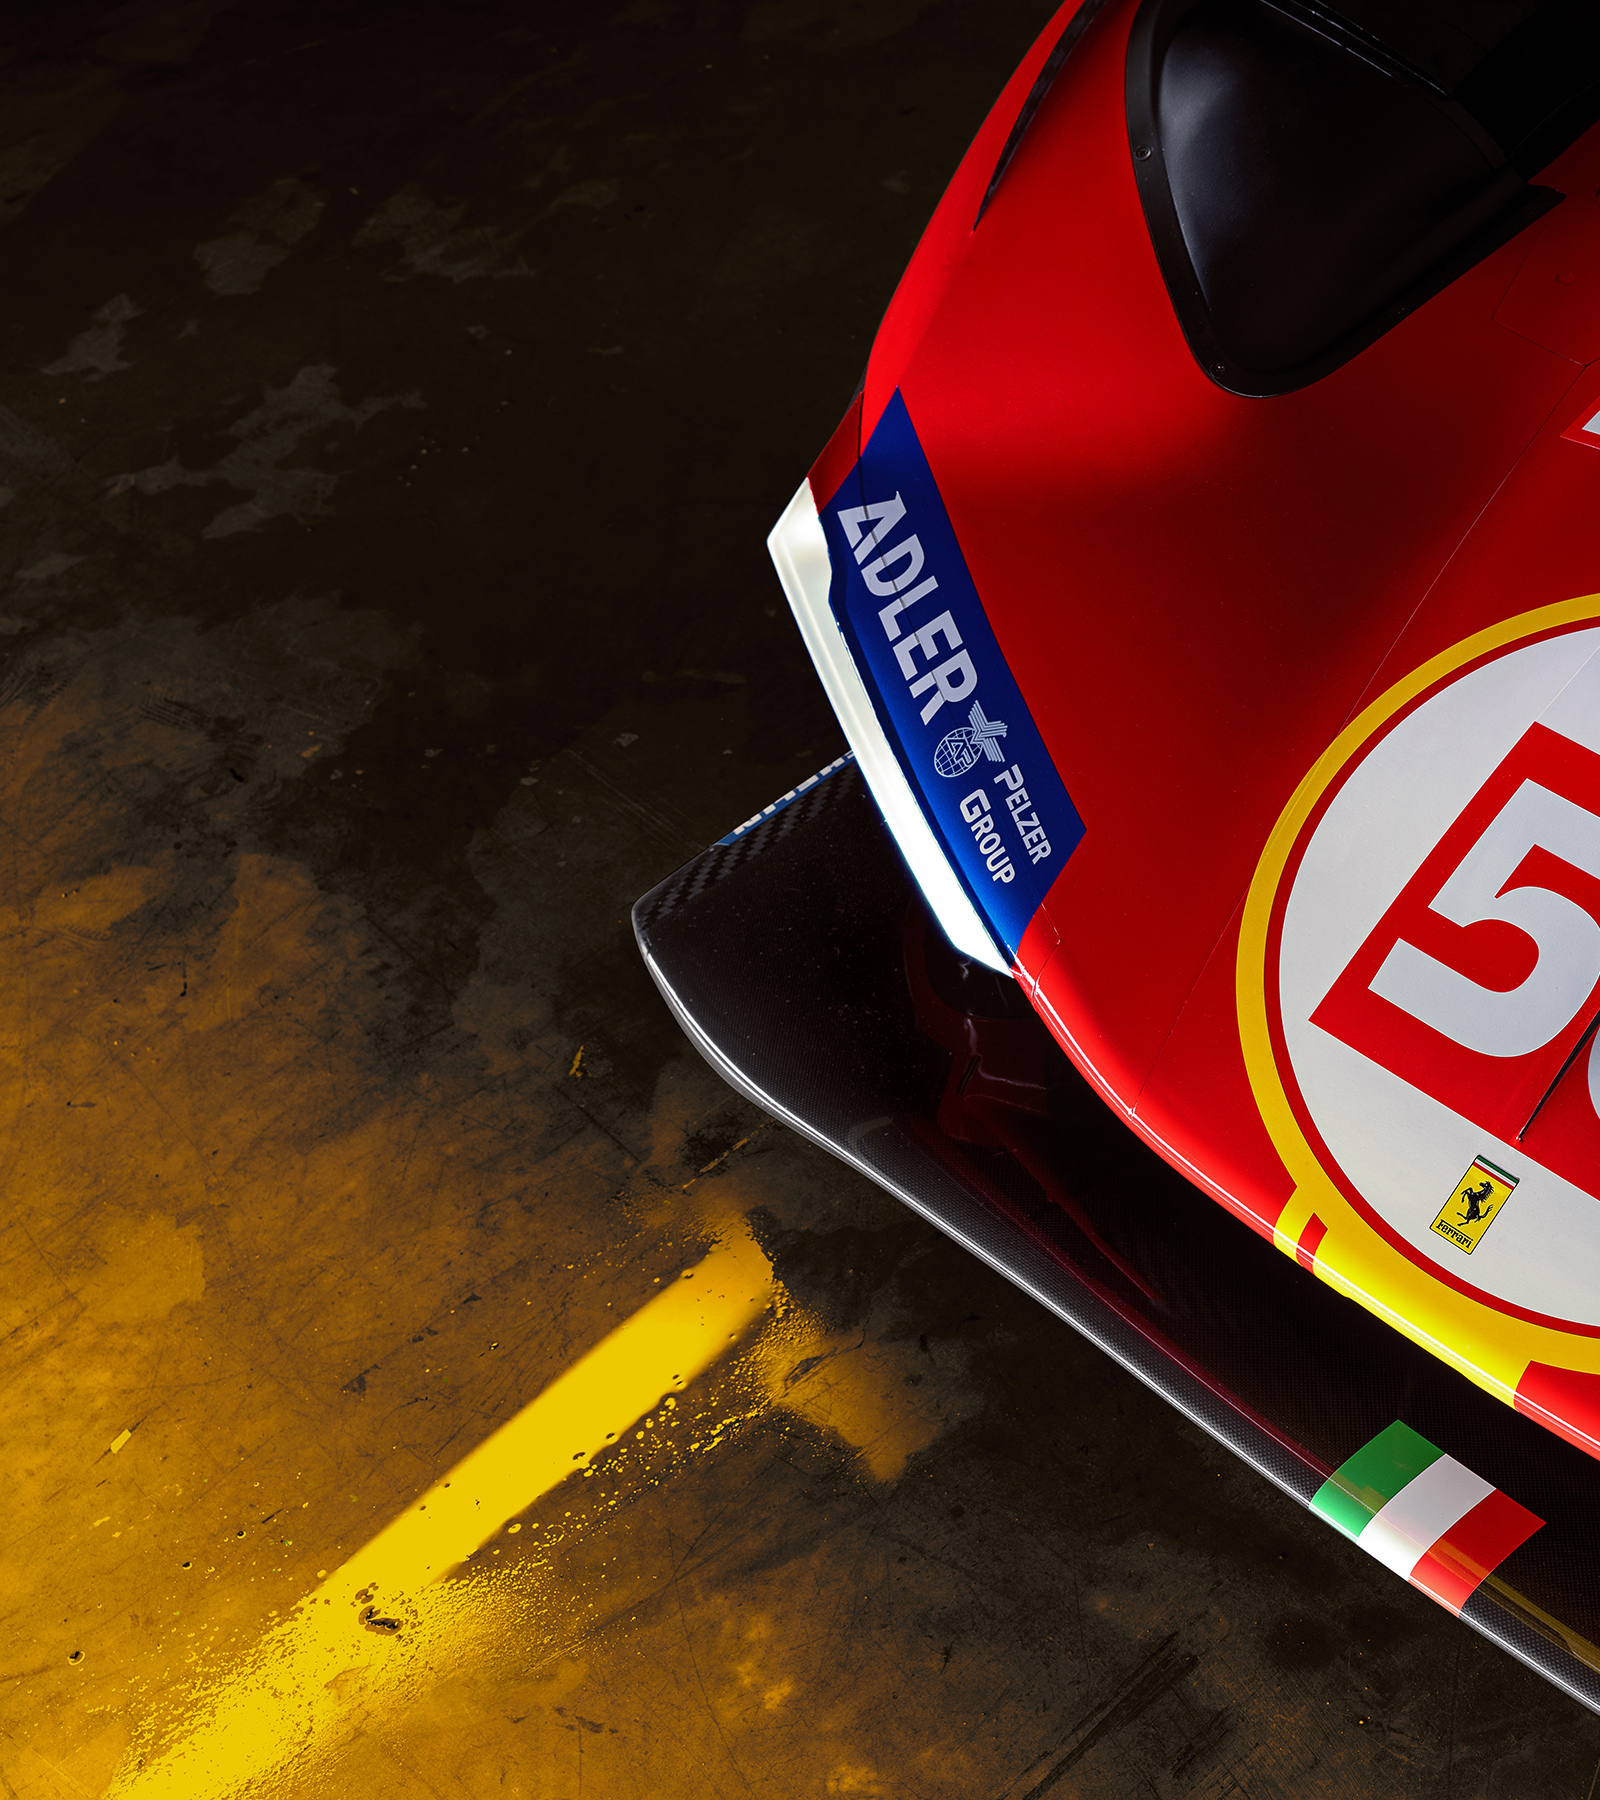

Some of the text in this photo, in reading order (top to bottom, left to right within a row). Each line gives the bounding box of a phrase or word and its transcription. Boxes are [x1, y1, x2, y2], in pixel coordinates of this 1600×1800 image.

[837, 490, 979, 726] ADLER
[959, 788, 1016, 883] GROUP
[993, 763, 1052, 865] PELZER
[1436, 1219, 1473, 1249] Ferrari
